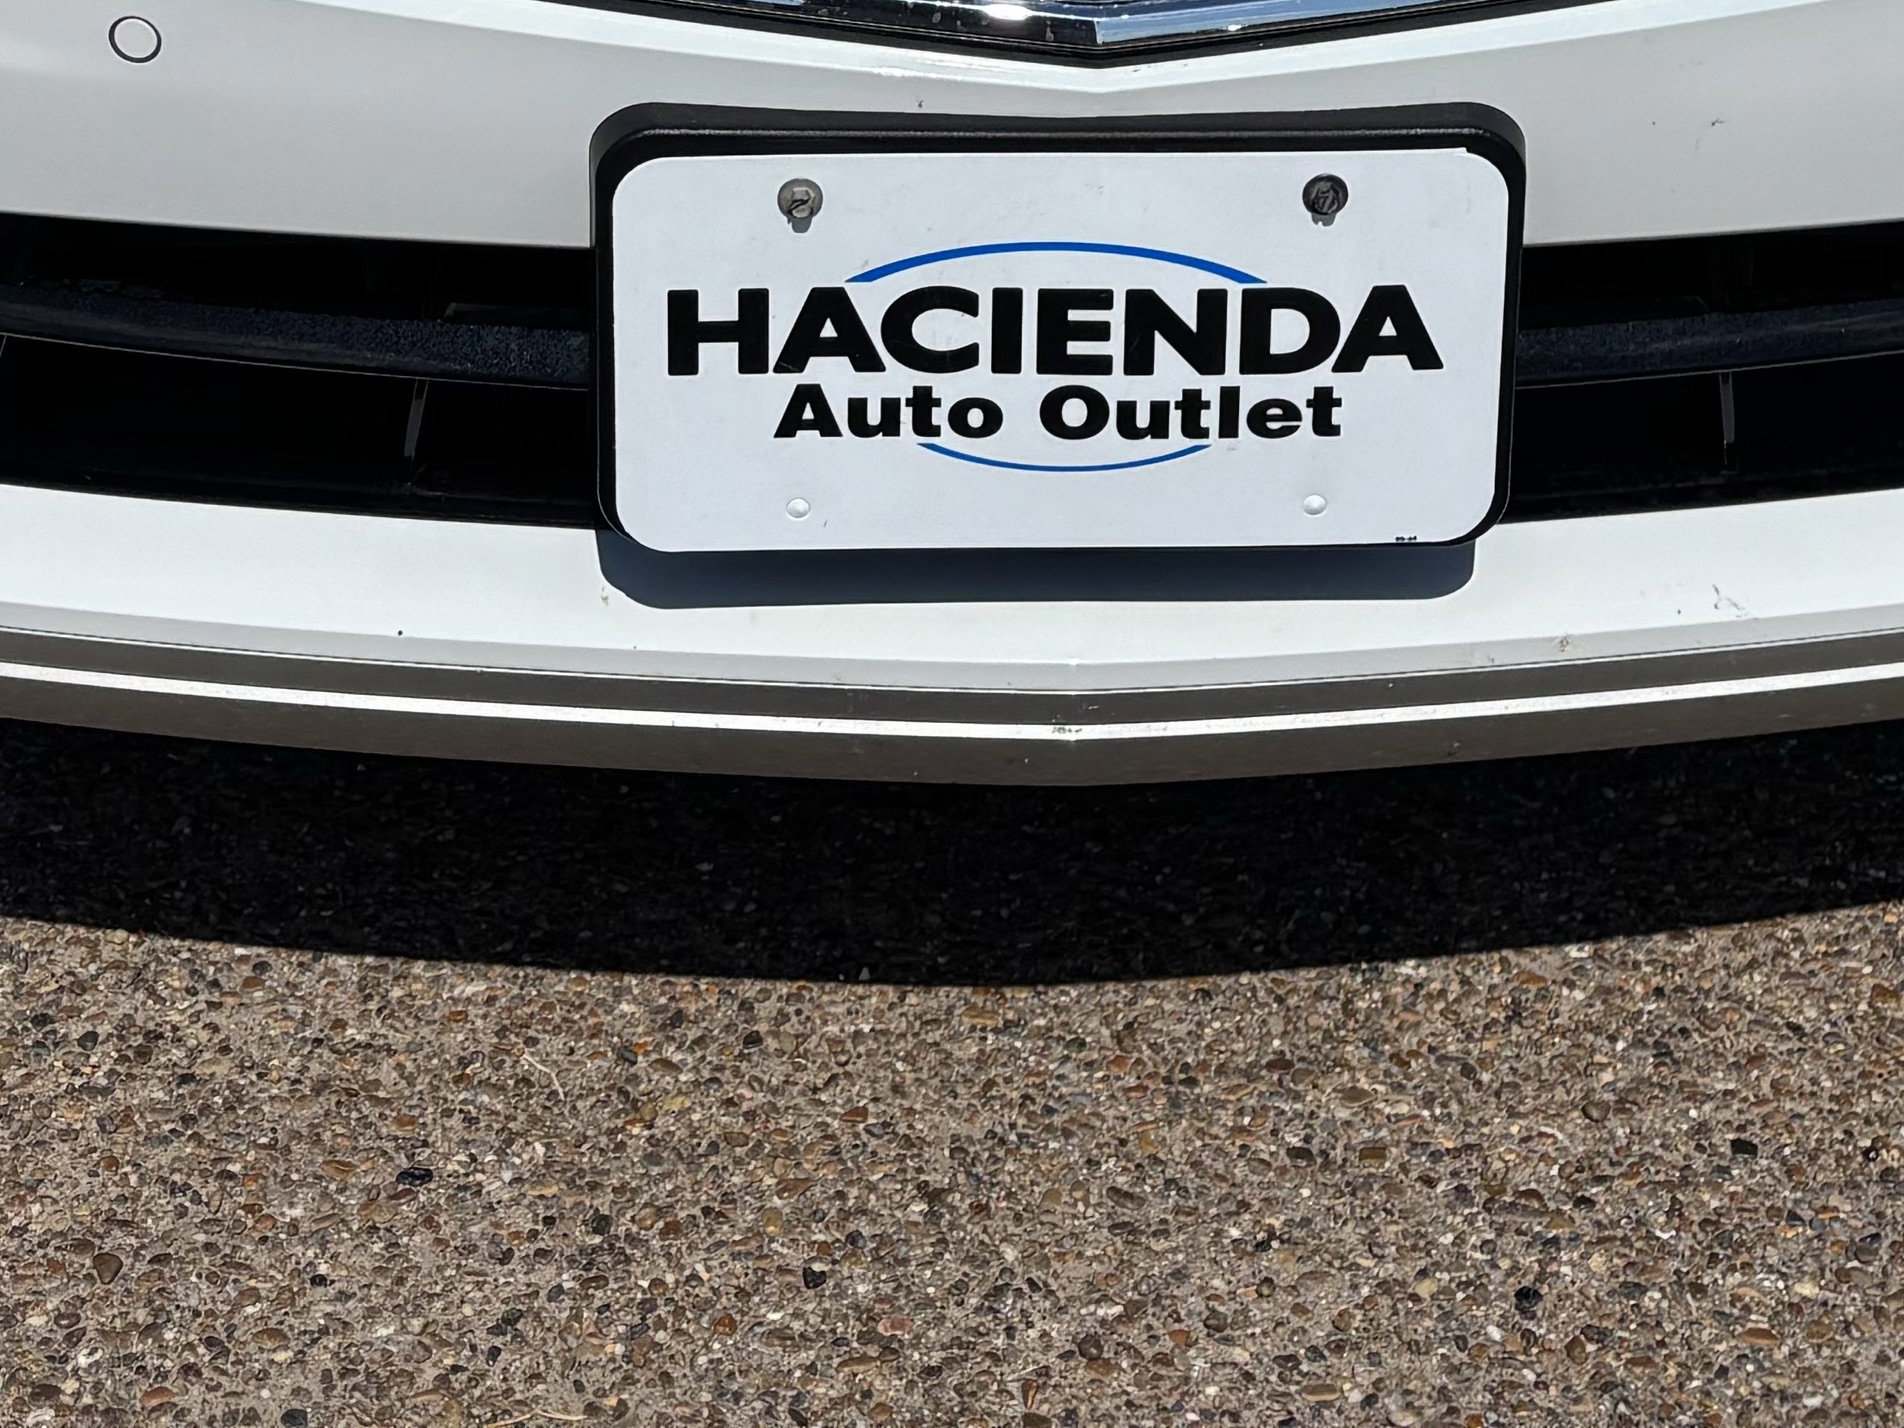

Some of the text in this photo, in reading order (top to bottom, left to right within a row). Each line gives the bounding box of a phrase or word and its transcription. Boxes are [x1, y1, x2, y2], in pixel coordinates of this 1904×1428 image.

[667, 284, 1444, 376] HACIENDA
[773, 383, 1342, 440] Auto Outlet
